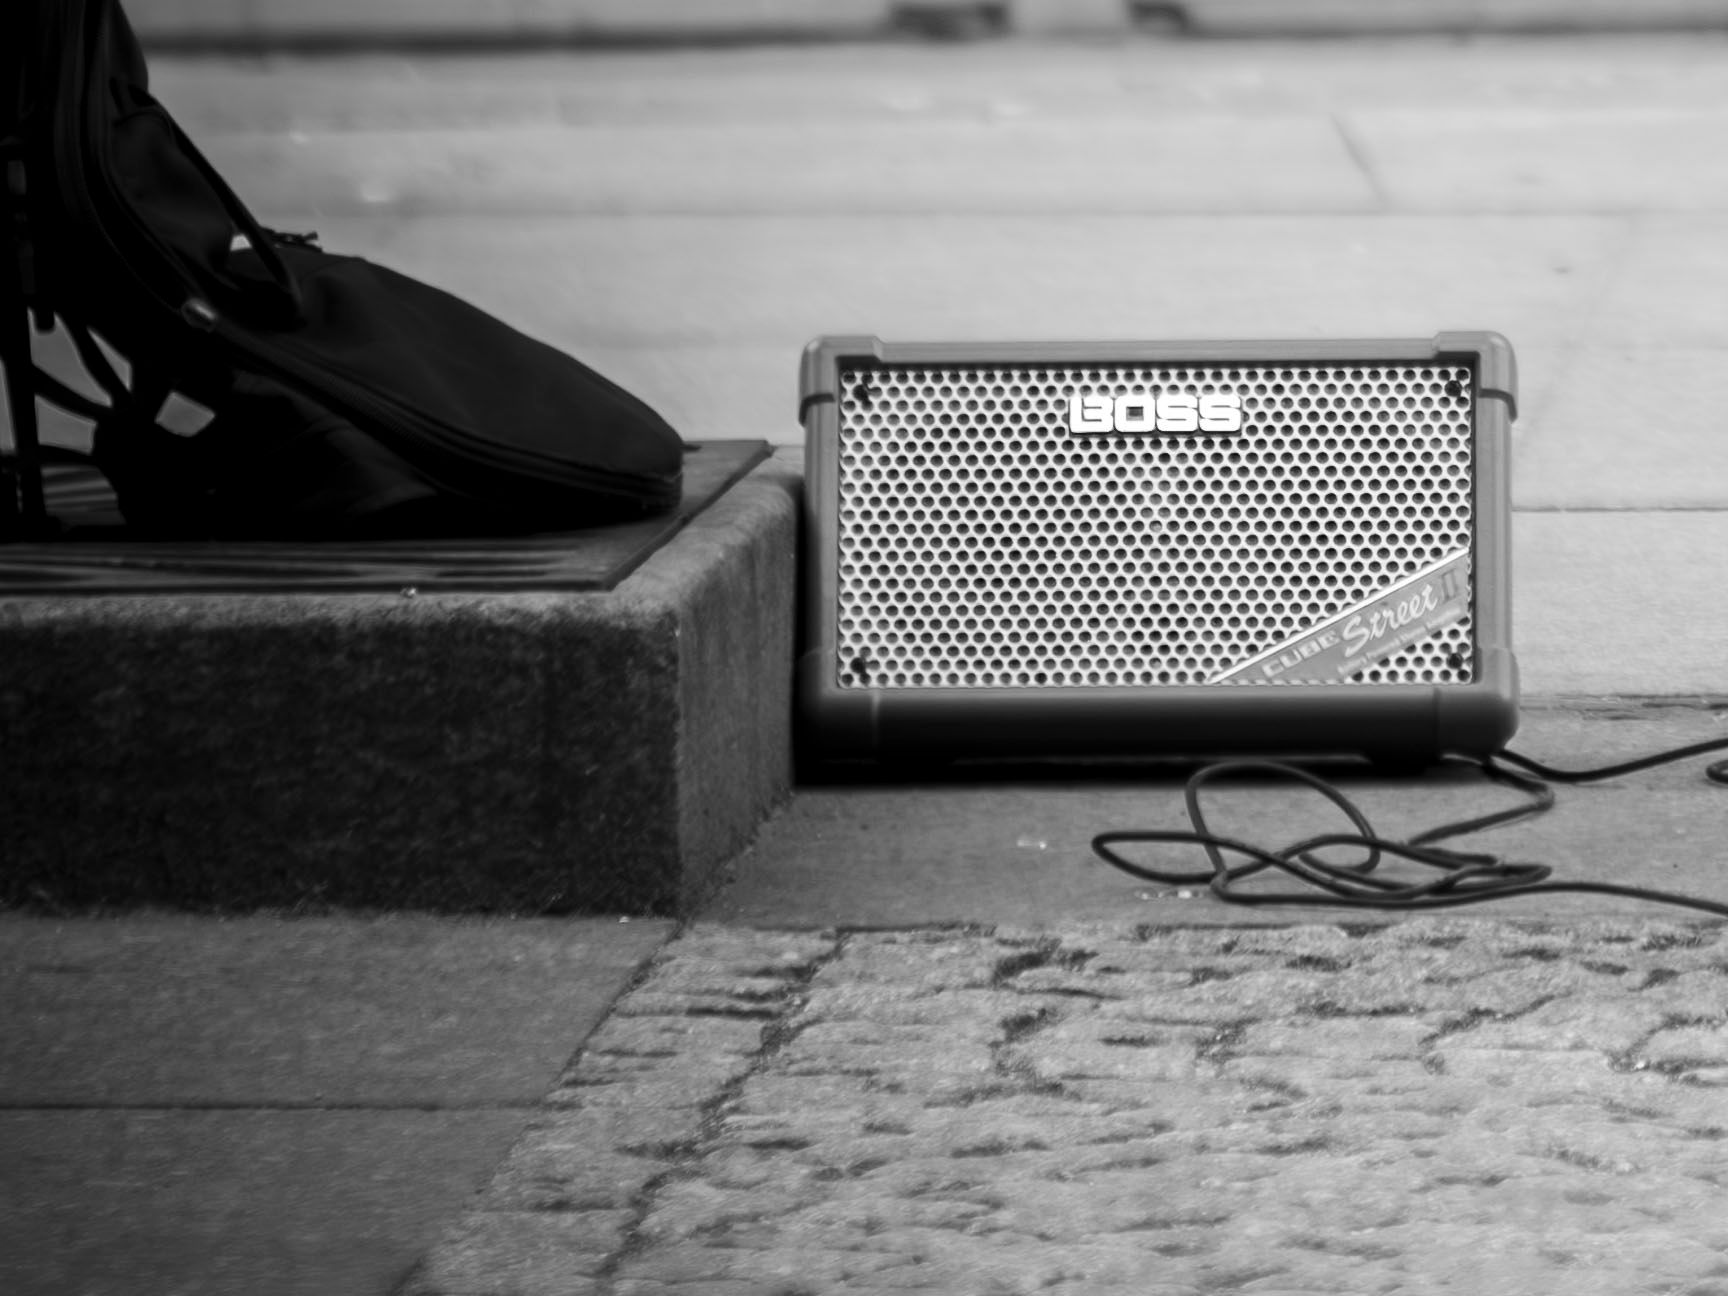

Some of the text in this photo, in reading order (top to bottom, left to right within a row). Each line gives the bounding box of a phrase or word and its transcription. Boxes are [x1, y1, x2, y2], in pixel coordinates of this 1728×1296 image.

[1069, 394, 1242, 434] BOSS
[1262, 630, 1340, 678] CUBE
[1343, 583, 1438, 657] Street
